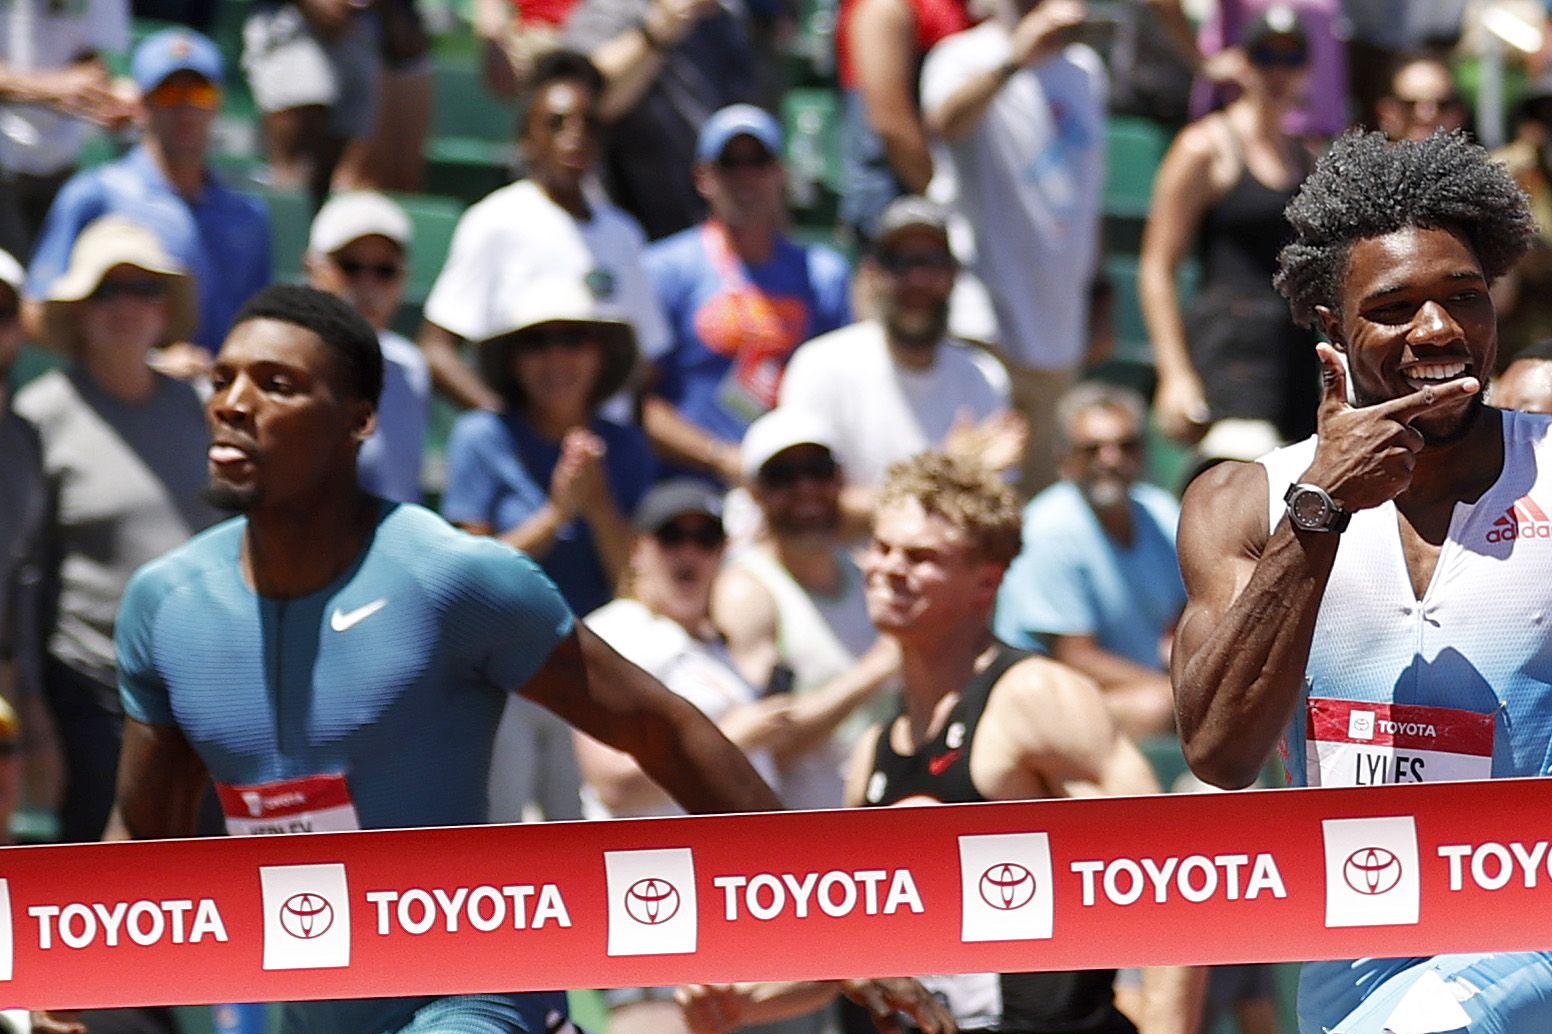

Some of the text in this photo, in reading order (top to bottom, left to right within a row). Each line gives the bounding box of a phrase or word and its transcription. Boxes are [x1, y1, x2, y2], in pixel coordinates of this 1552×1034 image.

[1378, 719, 1437, 737] TOYOTA
[29, 899, 228, 948] TOYOTA
[367, 884, 572, 934] TOYOTA
[714, 869, 924, 920] TOYOTA
[1071, 854, 1287, 905] TOYOTA
